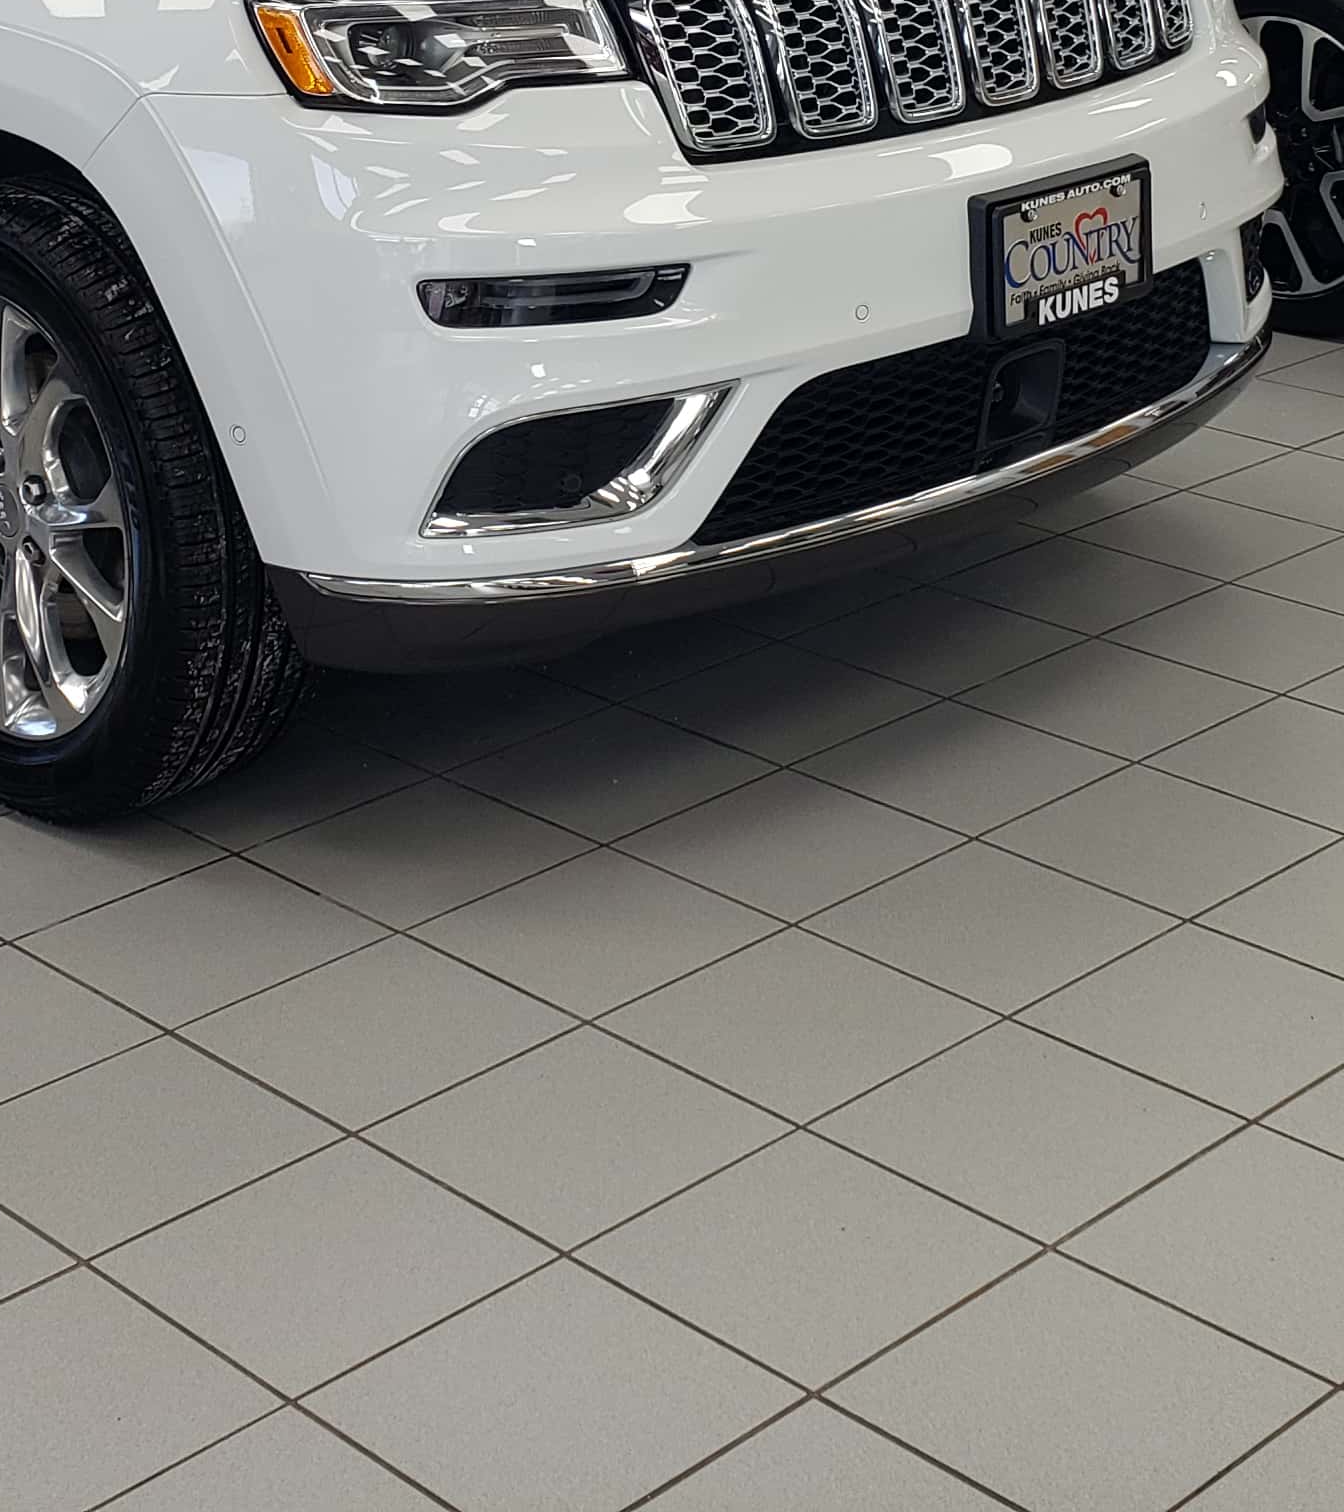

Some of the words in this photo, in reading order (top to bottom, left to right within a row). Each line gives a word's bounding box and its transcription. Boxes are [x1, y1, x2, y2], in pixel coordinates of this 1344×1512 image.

[1004, 215, 1143, 289] COUNTRY
[1029, 221, 1063, 245] KUNES
[1038, 276, 1120, 326] KUNES
